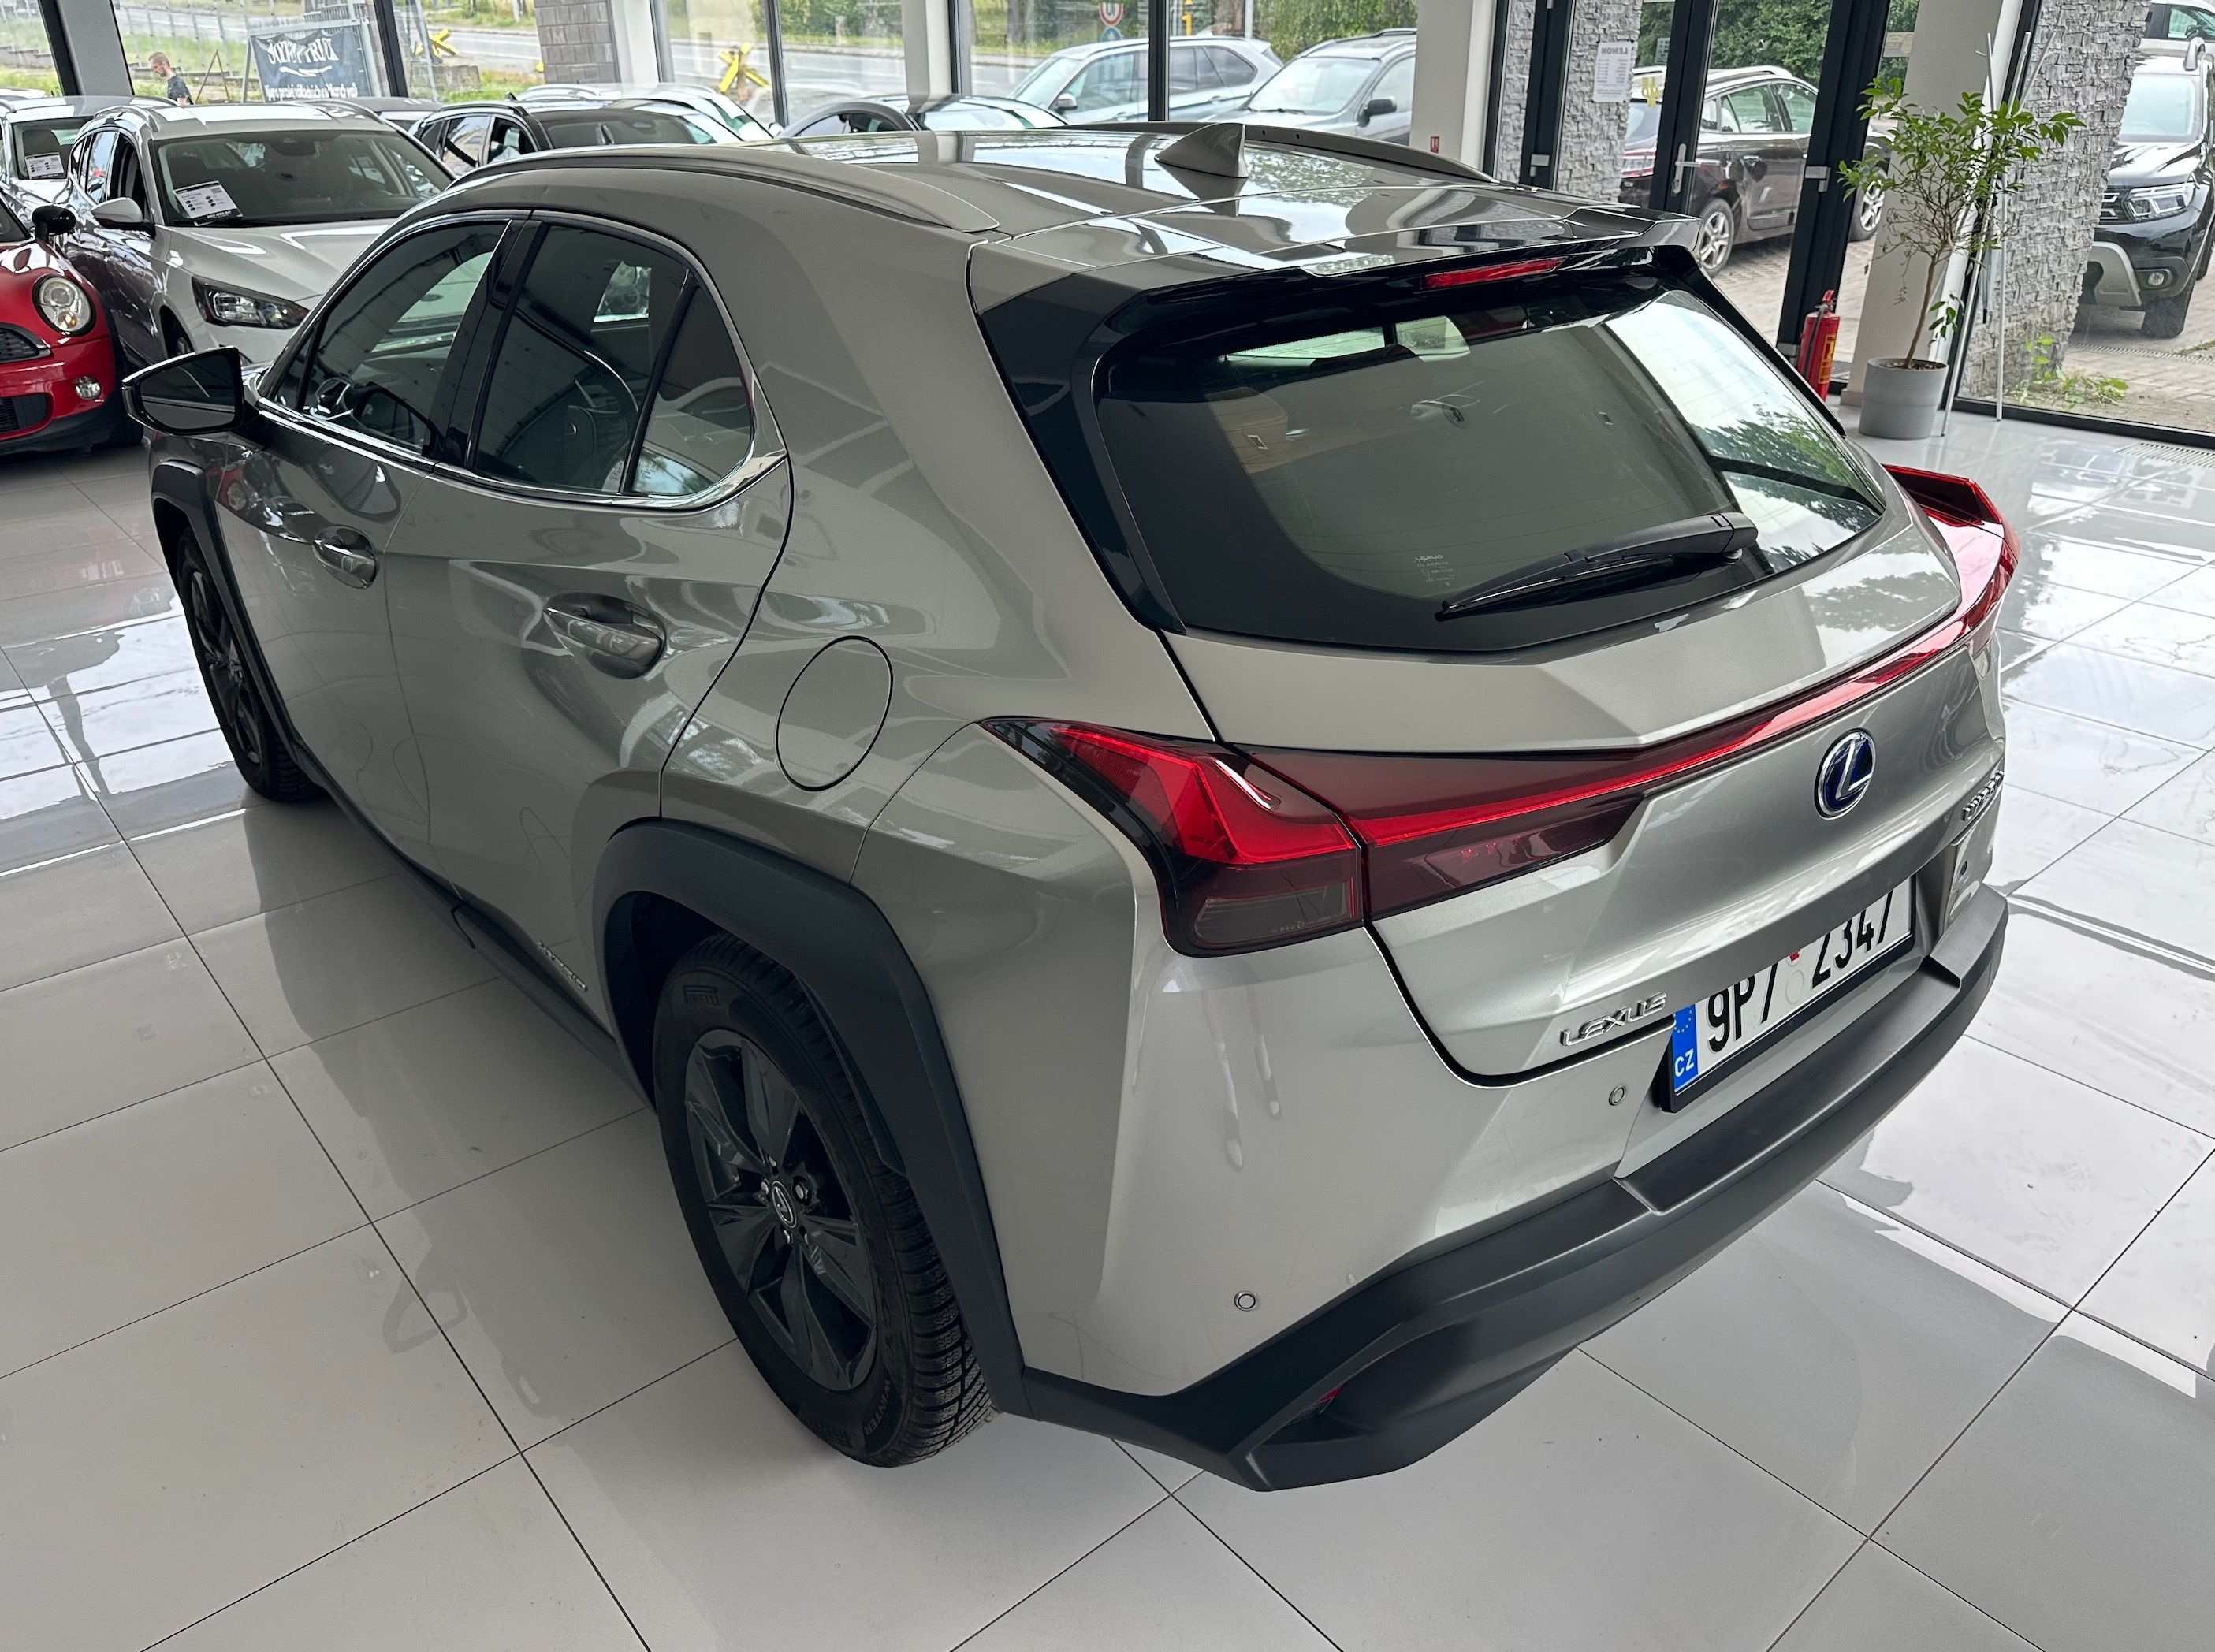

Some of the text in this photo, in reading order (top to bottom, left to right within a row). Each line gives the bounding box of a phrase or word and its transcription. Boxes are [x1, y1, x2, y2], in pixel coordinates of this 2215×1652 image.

[1707, 890, 1893, 1053] 9P7 2347
[1560, 991, 1667, 1046] LEXUS
[1674, 1048, 1695, 1077] CZ
[864, 1379, 891, 1435] WINTER
